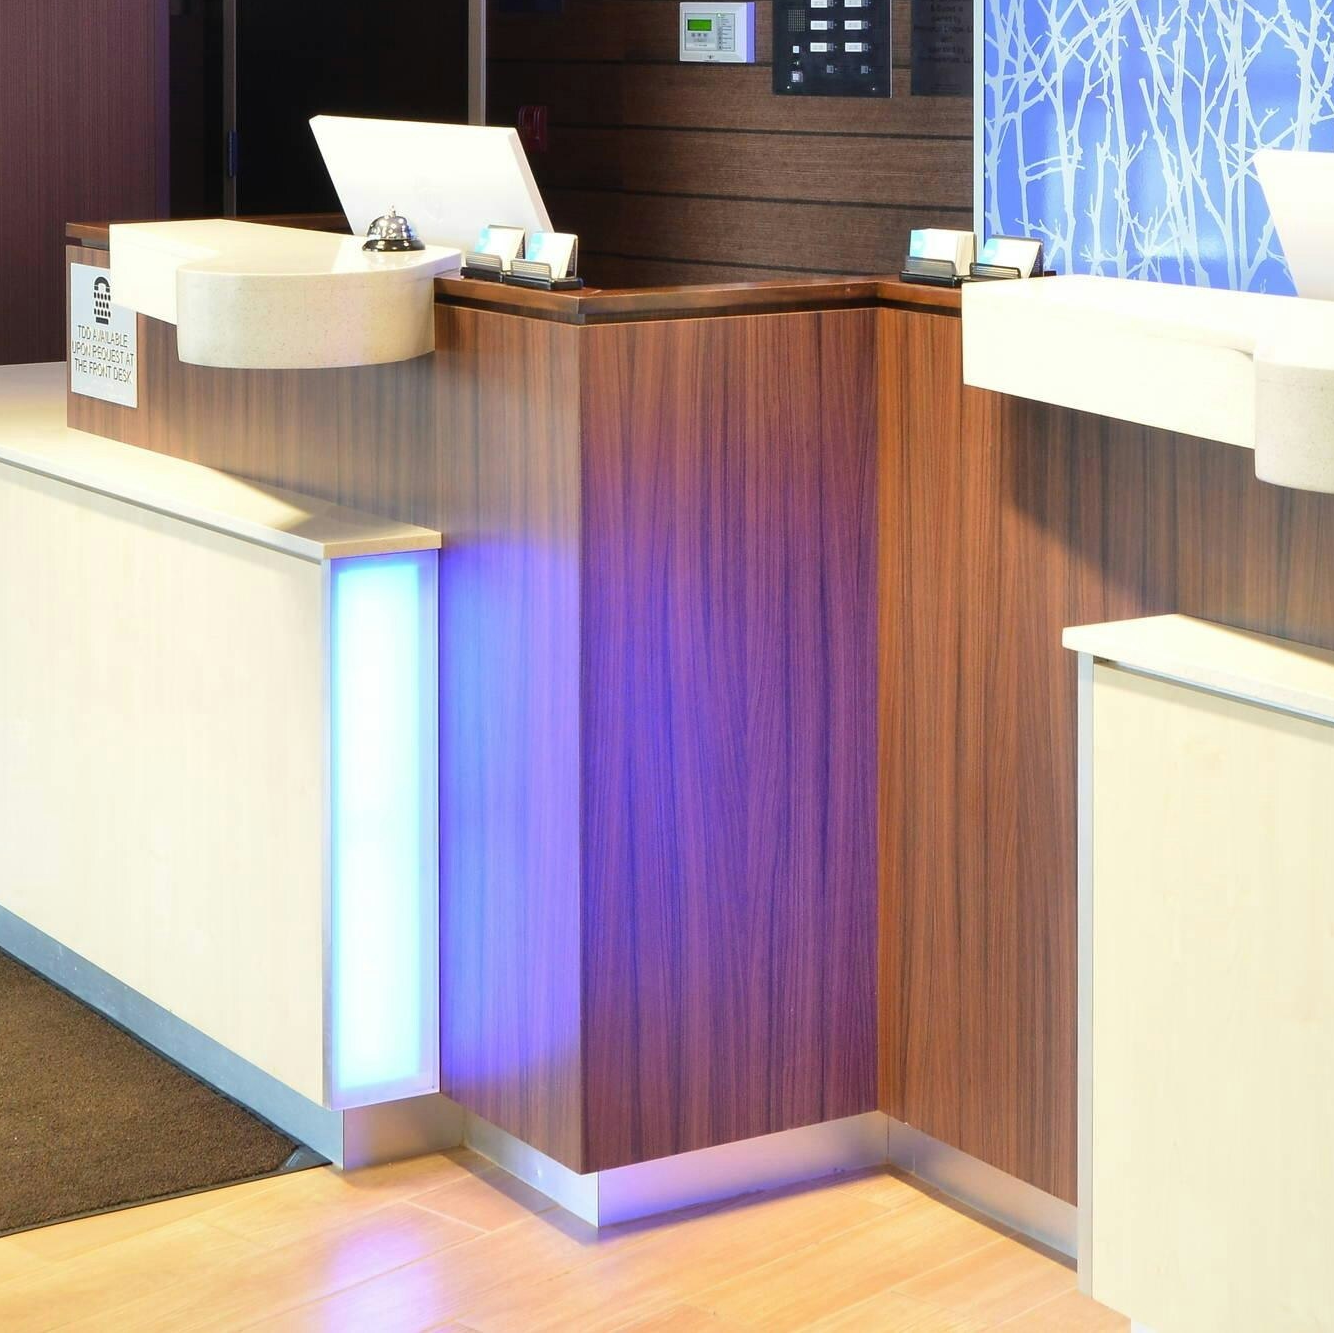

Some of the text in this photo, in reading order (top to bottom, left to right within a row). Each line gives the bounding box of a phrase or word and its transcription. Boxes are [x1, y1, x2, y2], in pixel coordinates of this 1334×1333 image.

[78, 325, 128, 348] TDD AVAILABLE
[72, 340, 134, 366] UPON REQUEST AT
[75, 358, 87, 373] THE
[89, 361, 111, 379] FRONT
